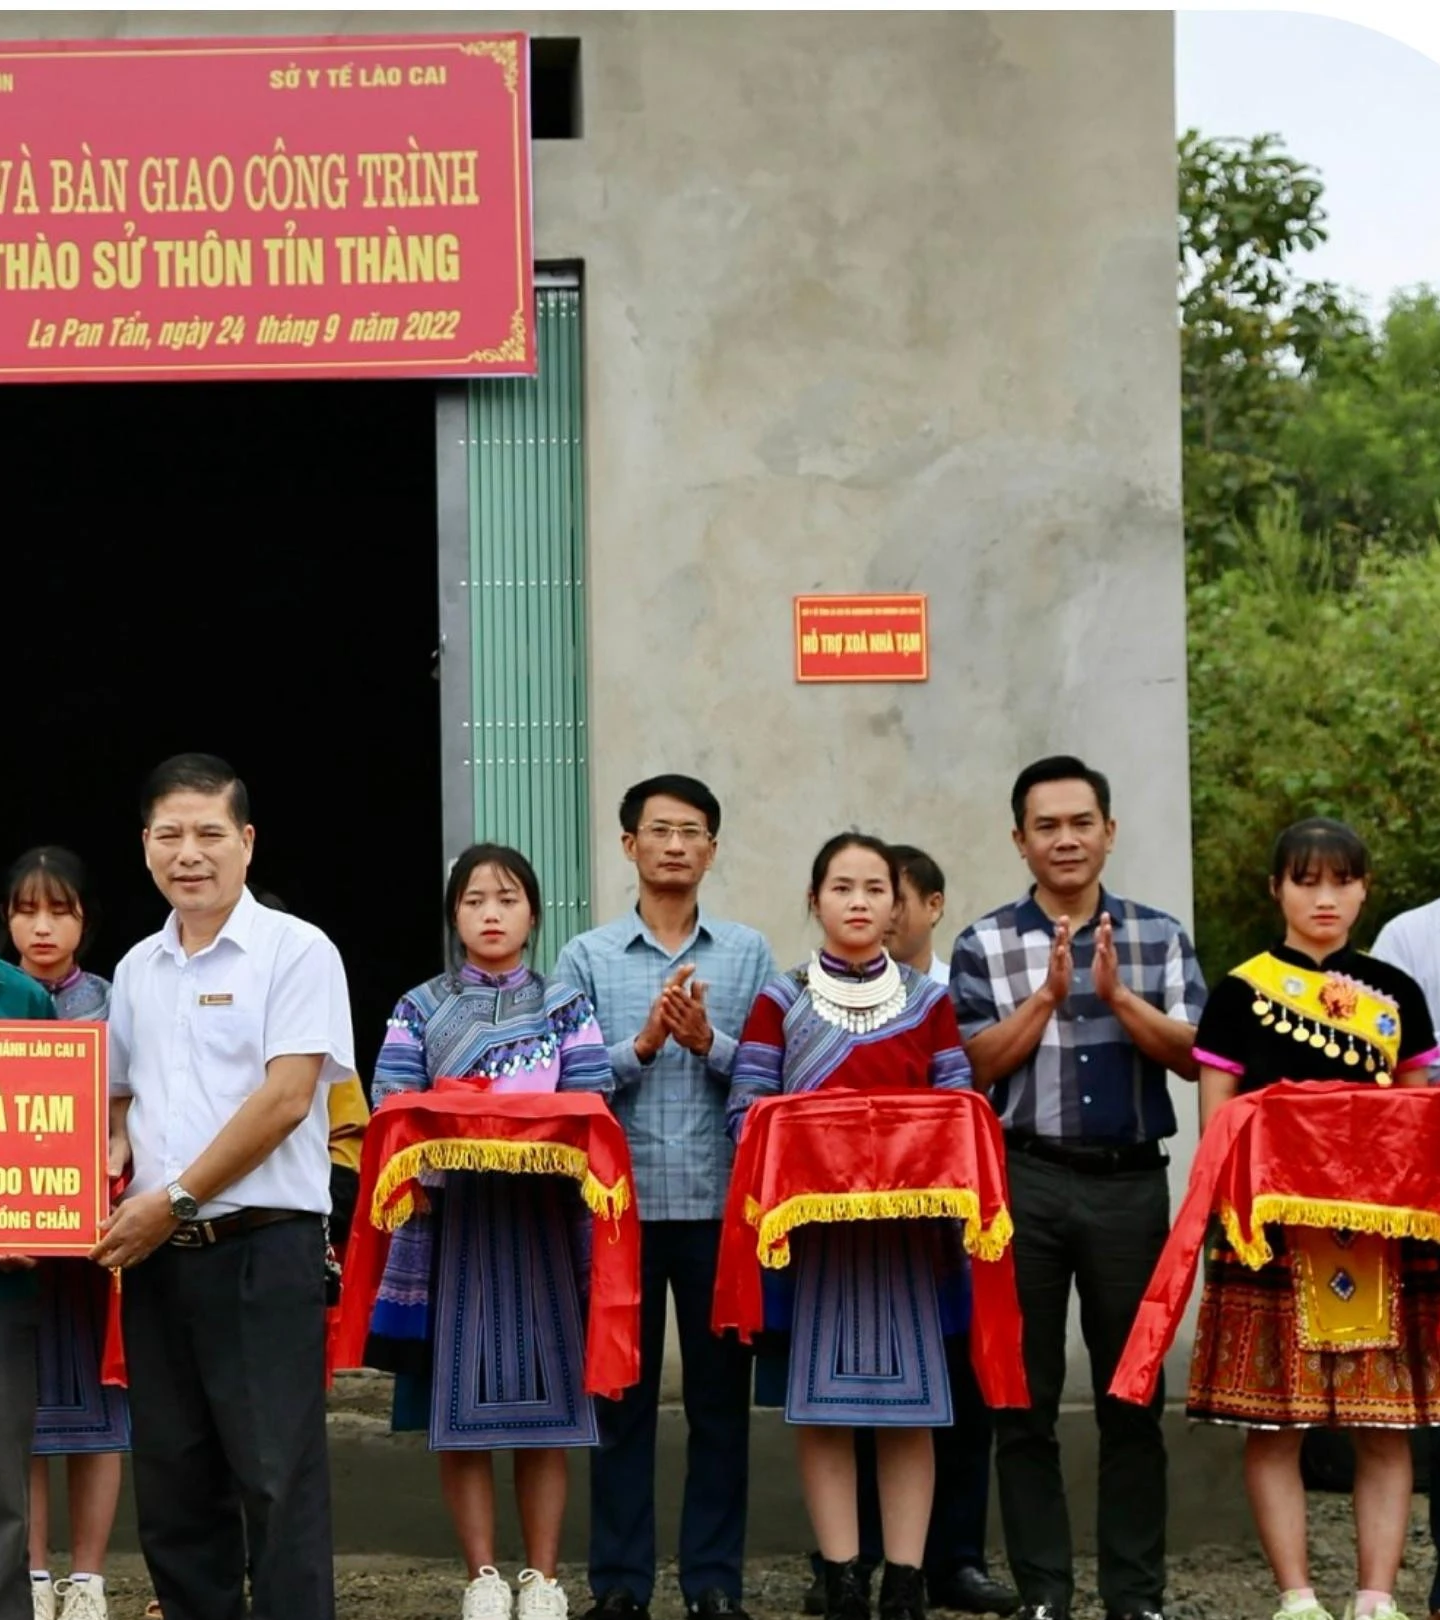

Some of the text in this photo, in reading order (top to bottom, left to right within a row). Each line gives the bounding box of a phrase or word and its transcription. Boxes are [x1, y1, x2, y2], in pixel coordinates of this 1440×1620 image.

[269, 62, 447, 89] SỞ Y TẾ LÀO CAI
[49, 142, 130, 214] BÀN
[138, 154, 235, 213] GIAO
[243, 135, 350, 211] CÔNG
[357, 135, 480, 208] TRÌNH
[92, 220, 147, 290] SỬ
[153, 228, 252, 289] THÔN
[263, 220, 325, 287] TỈN
[335, 225, 460, 285] THÀNG
[27, 318, 55, 349] La
[59, 317, 102, 348] Pan
[158, 314, 215, 351] ngày
[215, 315, 245, 345] 24
[256, 313, 318, 347] tháng
[323, 313, 341, 343] 9
[348, 312, 400, 342] năm
[402, 310, 461, 341] 2022
[29, 1039, 52, 1058] LÀO
[54, 1042, 75, 1058] CAI
[15, 1094, 75, 1142] TẠM
[29, 1167, 81, 1196] VNĐ
